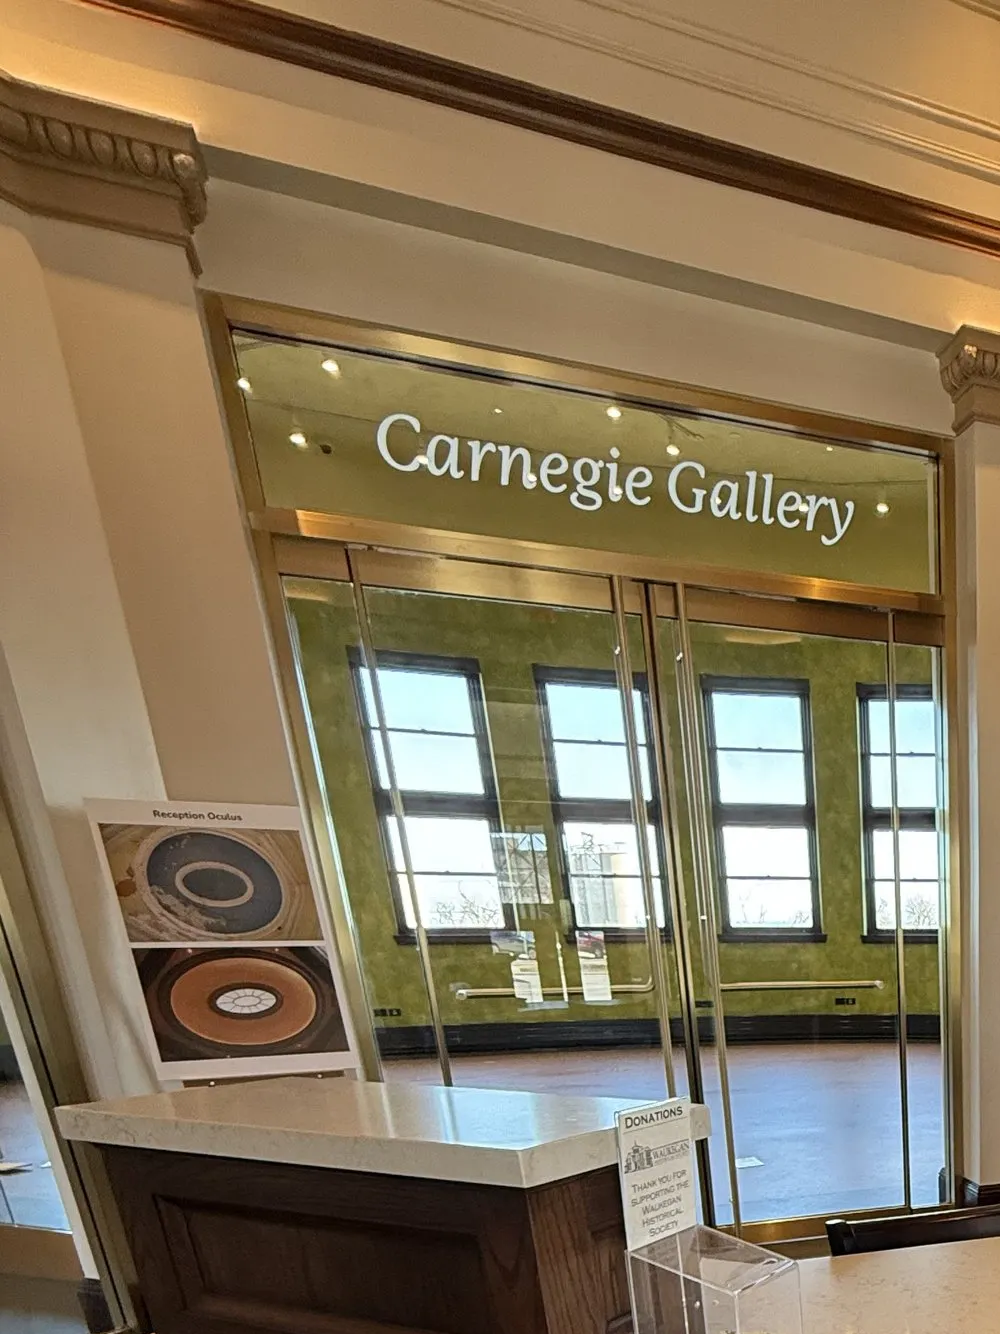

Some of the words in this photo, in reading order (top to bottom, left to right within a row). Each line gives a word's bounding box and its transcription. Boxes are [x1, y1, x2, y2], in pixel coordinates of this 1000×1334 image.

[376, 412, 653, 510] Carnegie
[667, 460, 855, 546] Gallery
[152, 809, 205, 820] Reception
[207, 812, 243, 821] Oculus
[625, 1106, 683, 1129] DONATIONS
[652, 1142, 690, 1160] WAUKEGAN
[631, 1179, 657, 1193] THANK
[658, 1173, 672, 1184] YOU
[673, 1169, 687, 1179] FOR
[631, 1185, 675, 1207] SUPPORTING
[676, 1179, 689, 1190] THE
[642, 1195, 682, 1215] WAUKEGAN
[643, 1208, 684, 1227] HISTORICAL
[649, 1220, 679, 1237] SOCIETY
